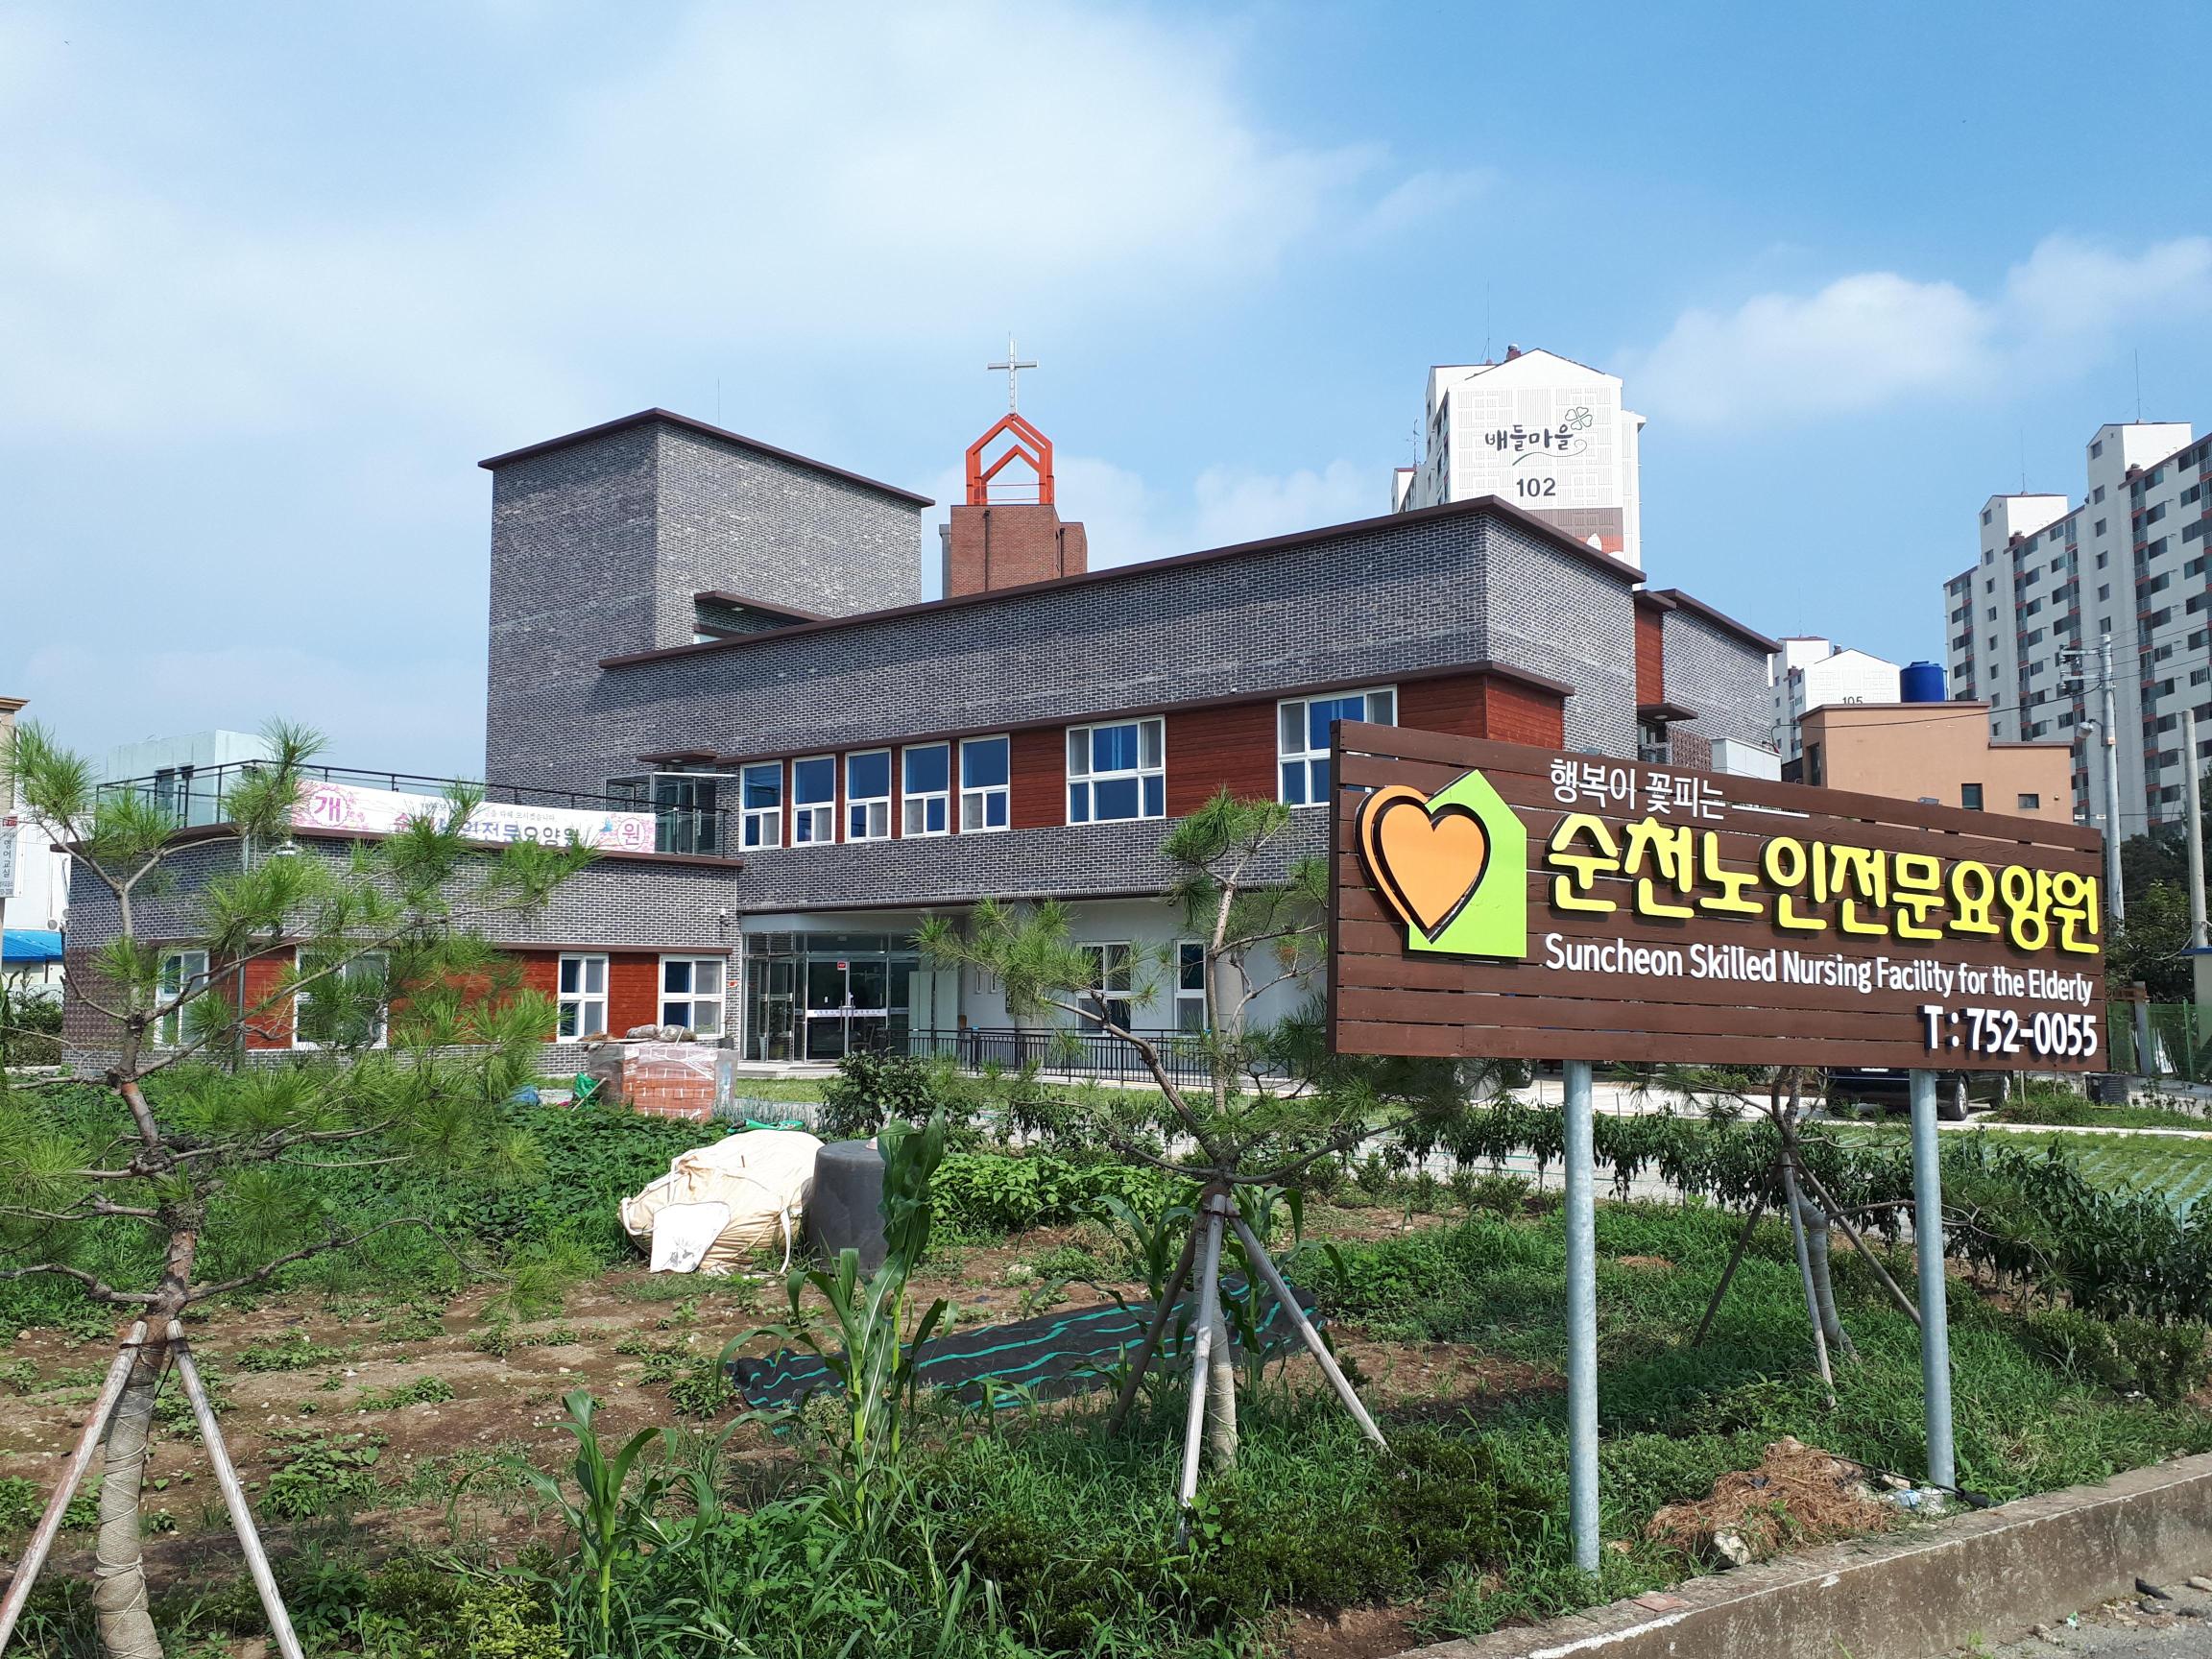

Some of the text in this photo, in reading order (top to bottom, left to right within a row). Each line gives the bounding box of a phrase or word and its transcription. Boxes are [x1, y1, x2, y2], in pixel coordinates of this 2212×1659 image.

[1484, 423, 1575, 452] 배들마을
[1516, 477, 1556, 497] 102
[1842, 696, 1863, 705] 105
[1550, 757, 1726, 821] 행복이 꽃피는
[313, 795, 342, 823] 개
[622, 822, 640, 847] 원
[1548, 813, 2101, 954] 순천노인전문요양원
[1544, 931, 2094, 1007] Suncheon Skilled Nursing Facility for the Elderly
